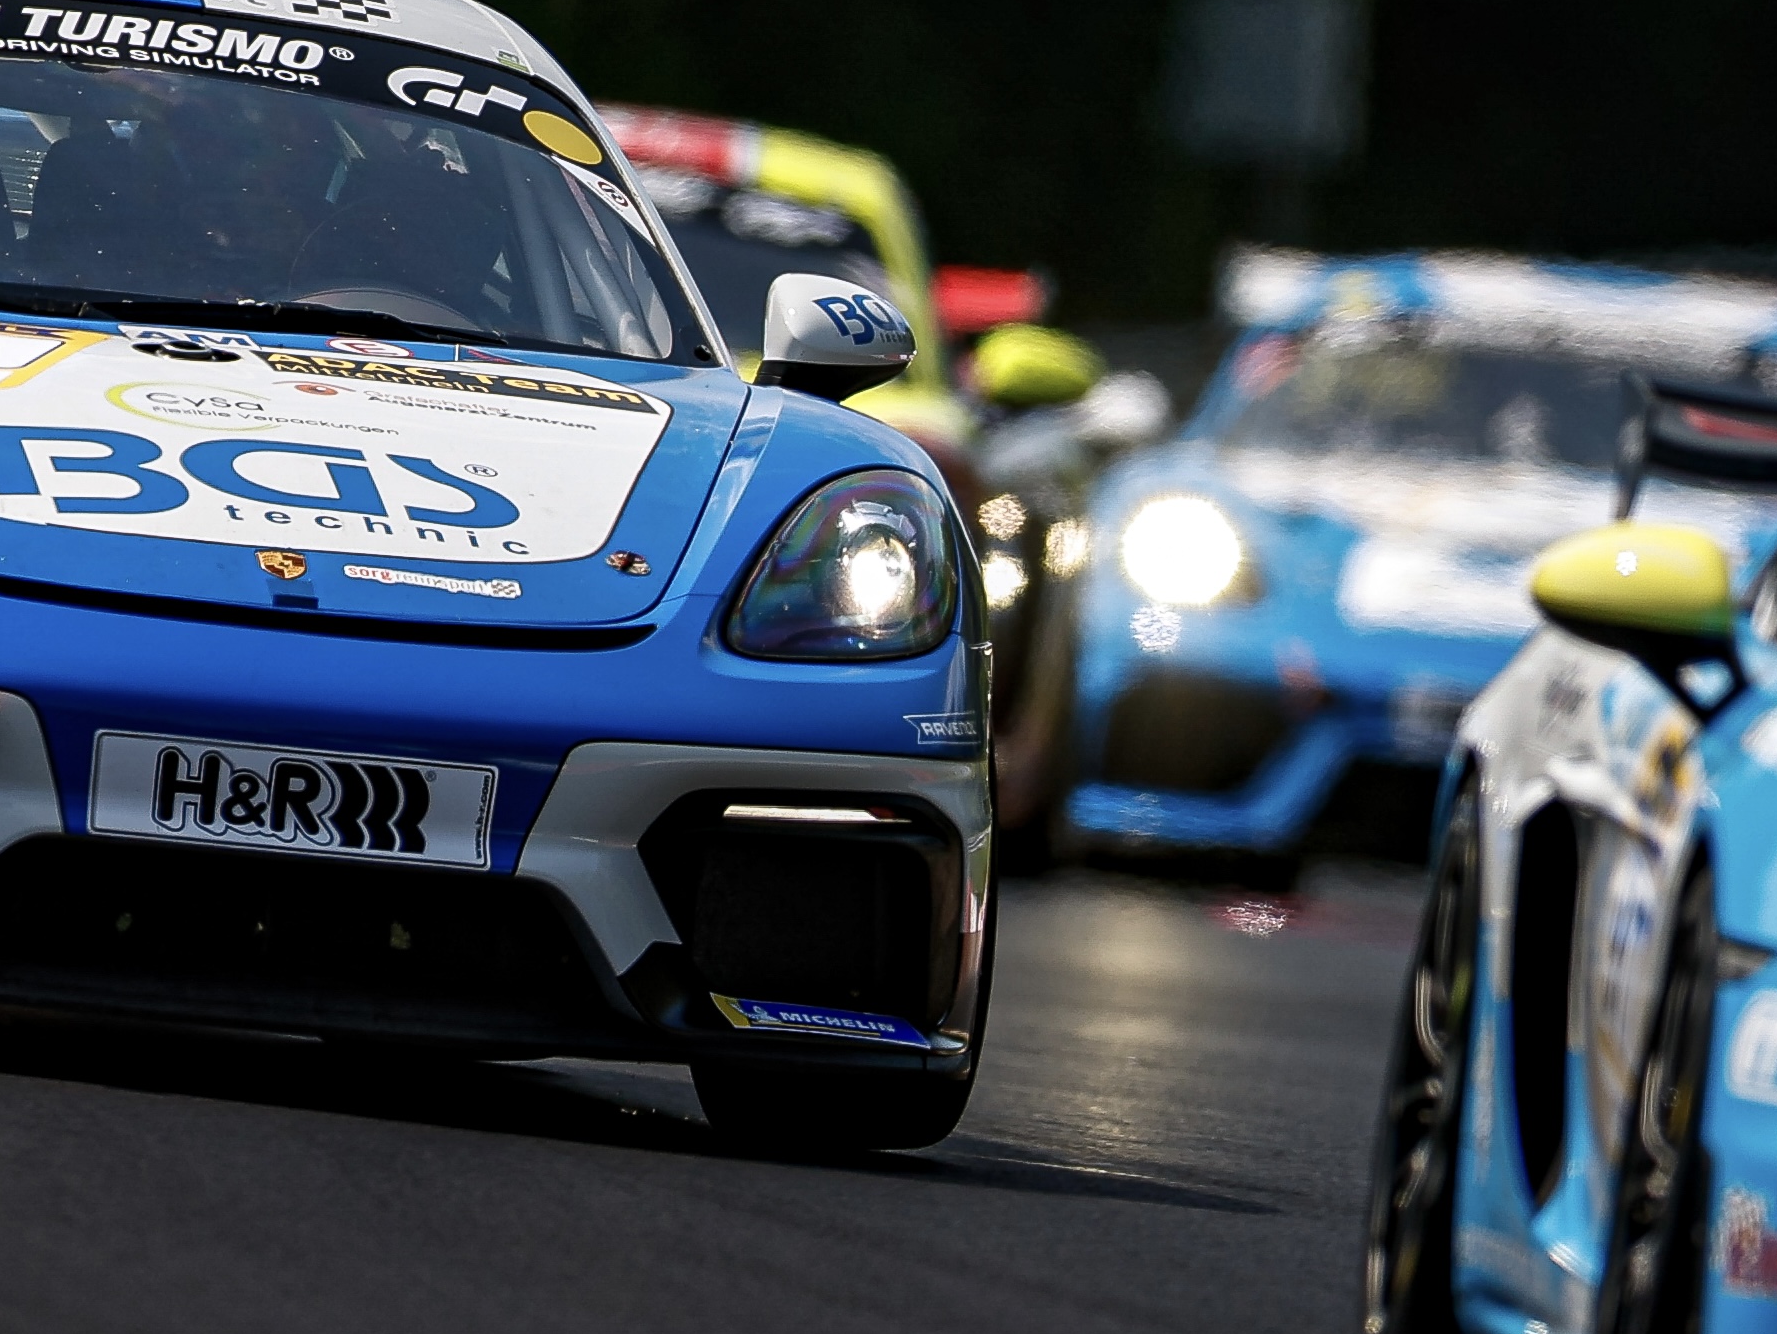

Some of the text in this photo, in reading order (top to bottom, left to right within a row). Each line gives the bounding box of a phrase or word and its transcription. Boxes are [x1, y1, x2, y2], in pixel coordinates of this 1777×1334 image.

[128, 49, 321, 85] SIMULATOR
[267, 354, 642, 403] ADAC Team
[275, 363, 490, 394] Mittelrhein
[237, 412, 400, 435] Verpackungen
[225, 503, 530, 555] technic
[347, 566, 392, 582] sorg
[154, 748, 332, 842] H&R
[778, 1011, 896, 1033] MICHELIN
